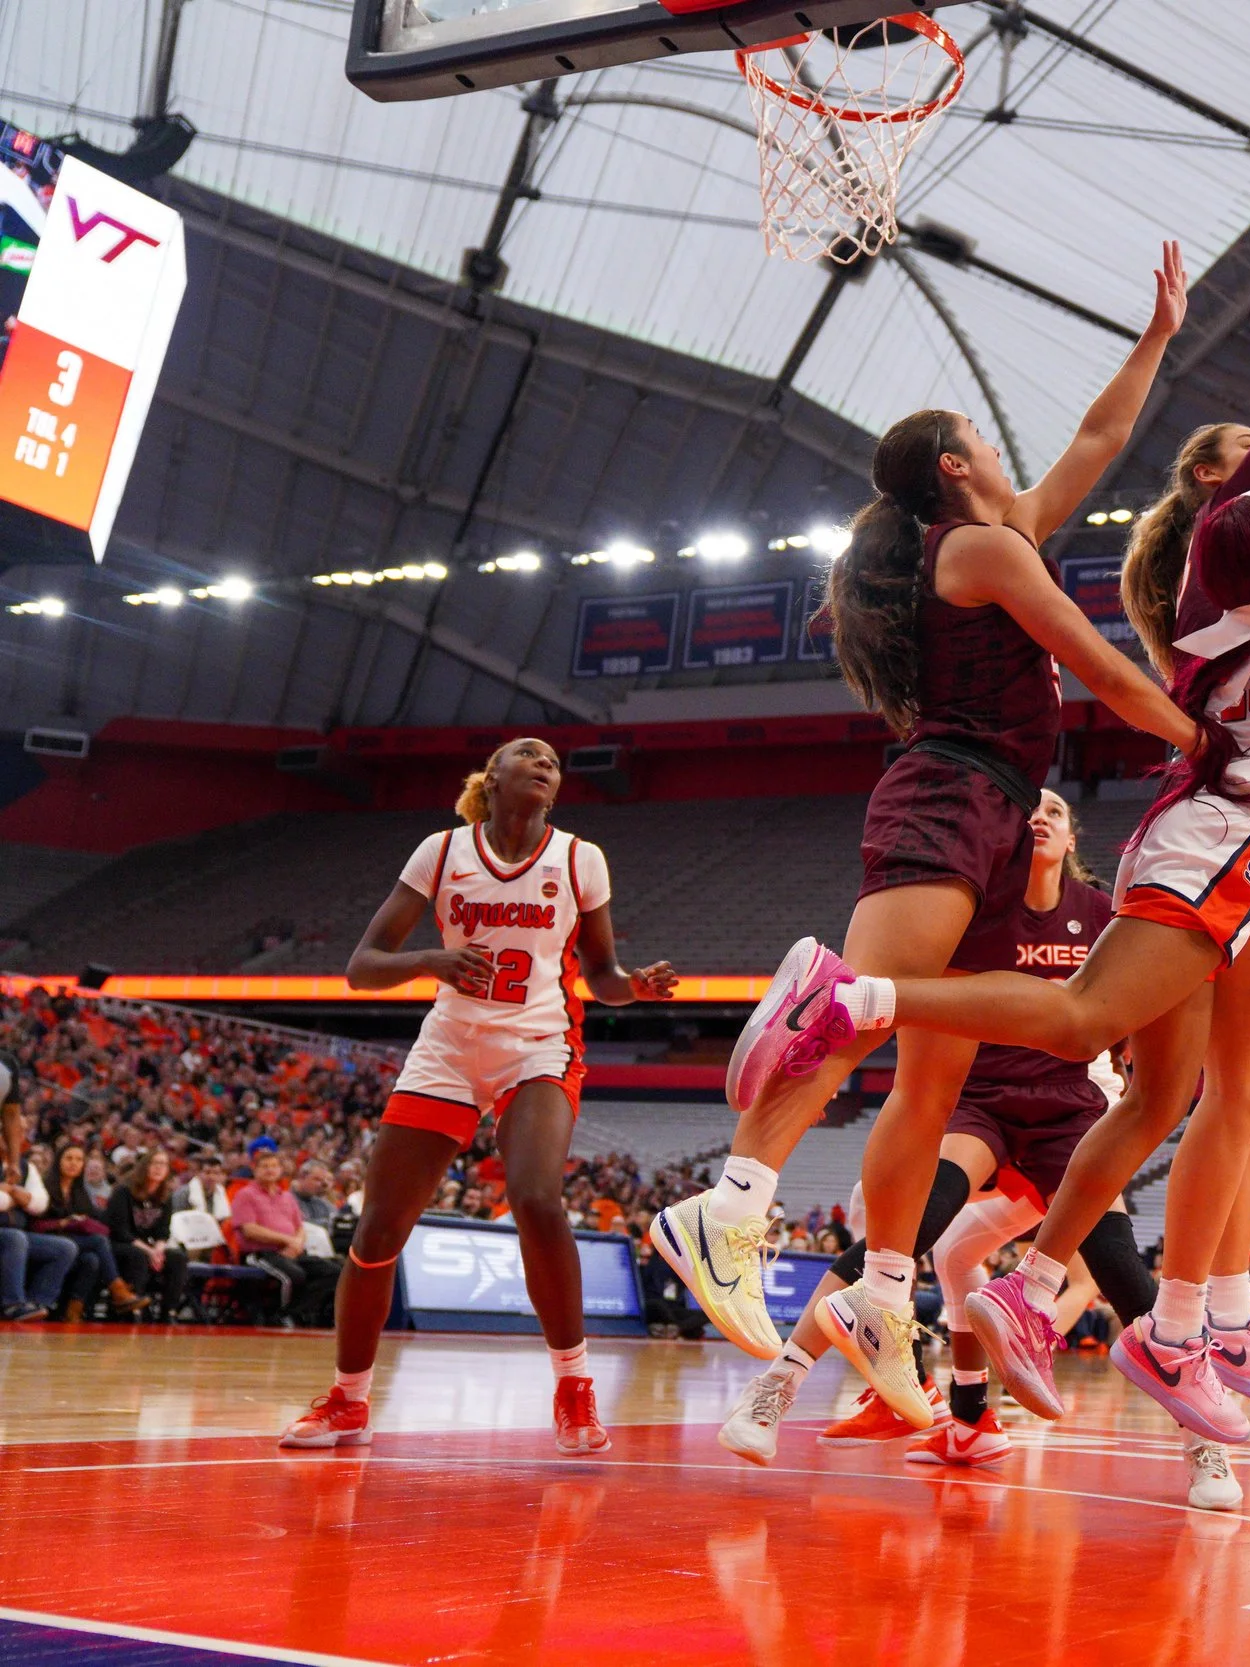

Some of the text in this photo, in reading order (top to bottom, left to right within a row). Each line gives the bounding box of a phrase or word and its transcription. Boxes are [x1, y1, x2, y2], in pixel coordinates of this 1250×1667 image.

[67, 195, 161, 264] VT
[48, 350, 84, 407] 3
[60, 423, 77, 448] 4
[55, 452, 69, 477] 1
[450, 894, 556, 937] Syracuse
[421, 1231, 526, 1303] SR
